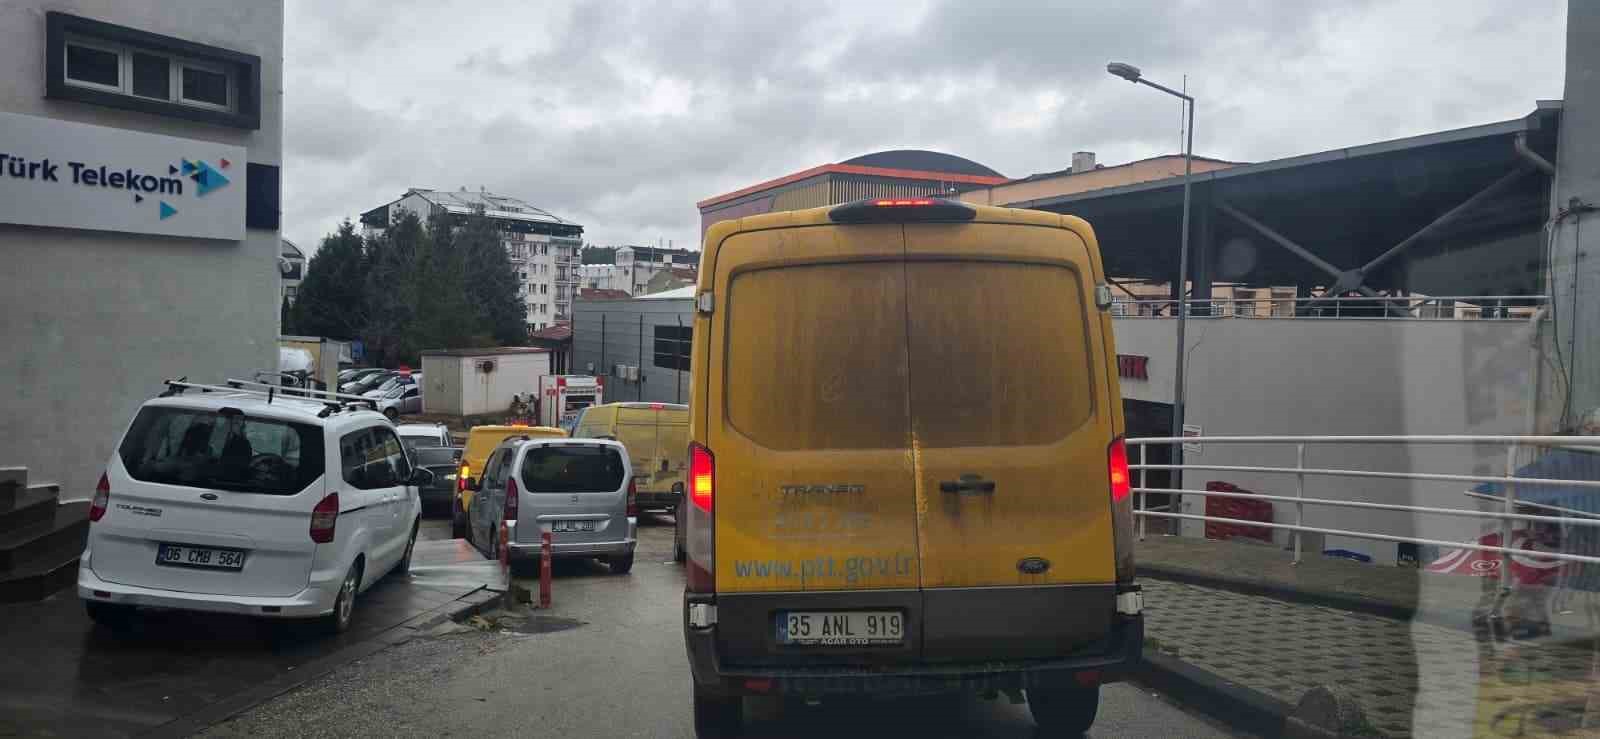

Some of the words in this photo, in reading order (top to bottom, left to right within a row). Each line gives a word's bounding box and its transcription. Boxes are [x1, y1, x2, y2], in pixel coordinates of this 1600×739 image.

[0, 153, 58, 182] Türk
[68, 161, 183, 195] Telekom
[166, 547, 181, 561] 06
[188, 549, 211, 564] CMB
[219, 551, 241, 566] 564
[789, 615, 810, 636] 35
[822, 615, 855, 636] ANL
[867, 615, 900, 636] 919
